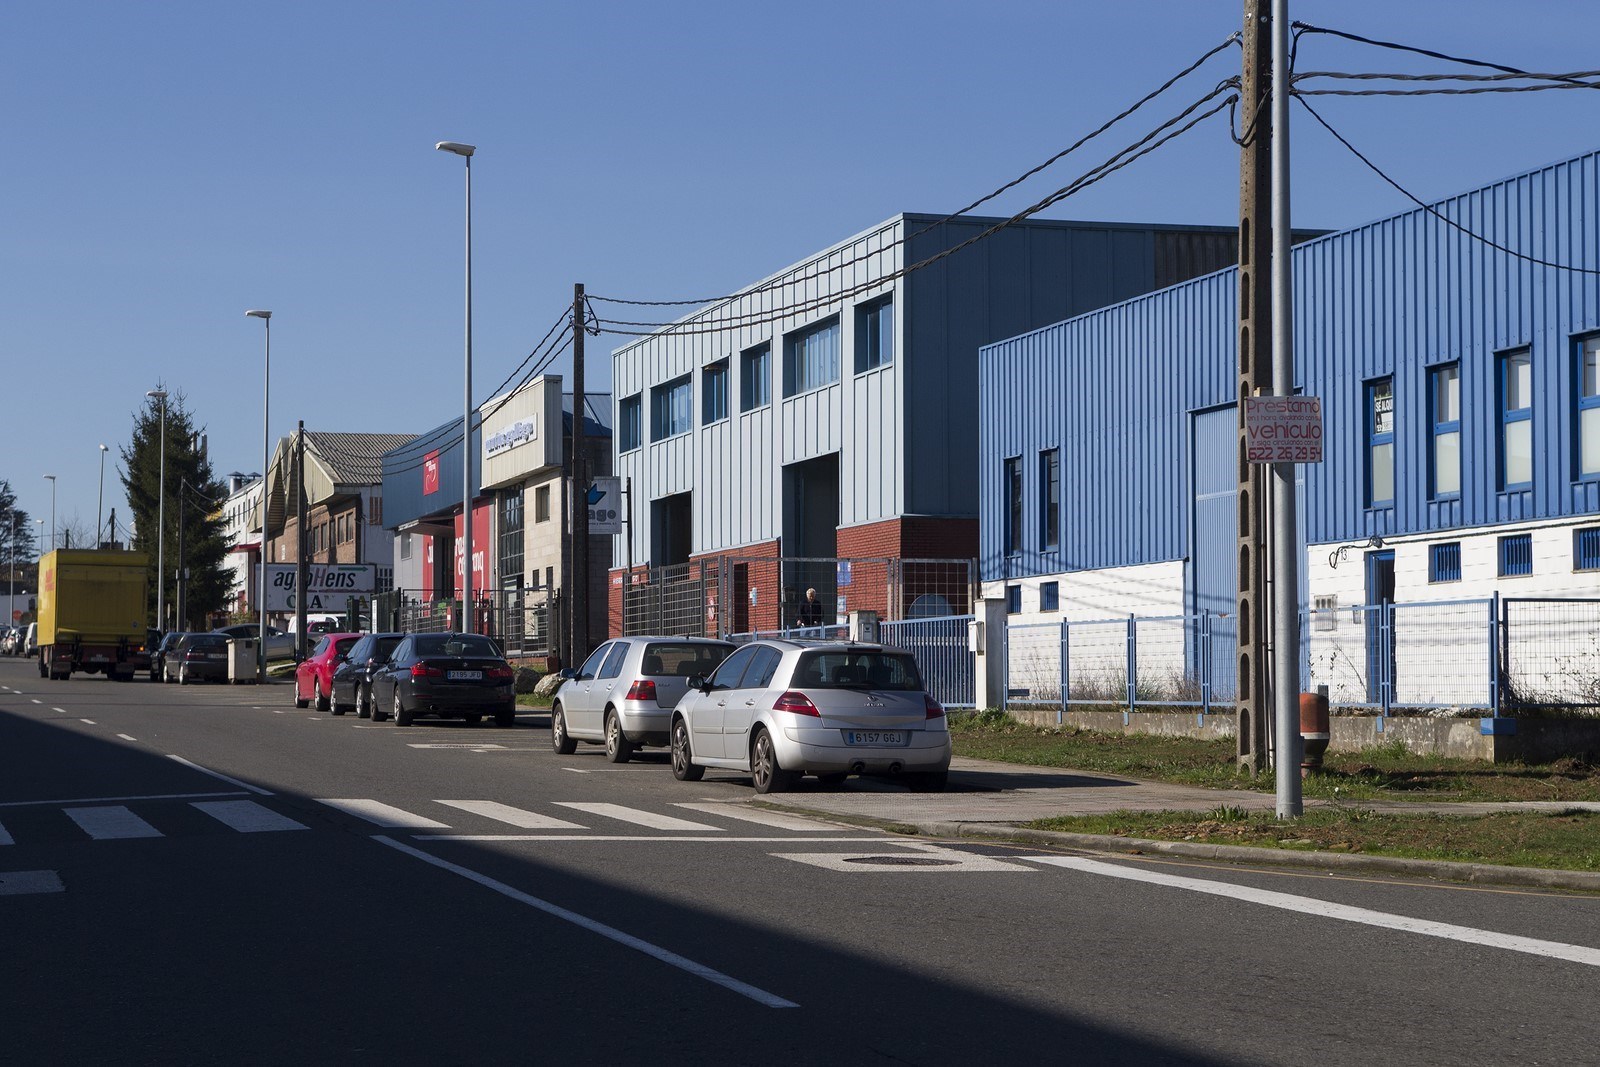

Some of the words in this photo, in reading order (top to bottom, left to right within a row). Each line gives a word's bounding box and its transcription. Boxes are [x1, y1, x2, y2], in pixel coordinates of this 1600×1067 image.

[1248, 447, 1274, 460] 622
[1277, 447, 1293, 460] 26
[1295, 446, 1308, 460] 29
[1309, 446, 1322, 460] 54
[856, 732, 880, 743] 6157
[883, 733, 901, 743] GGJ
